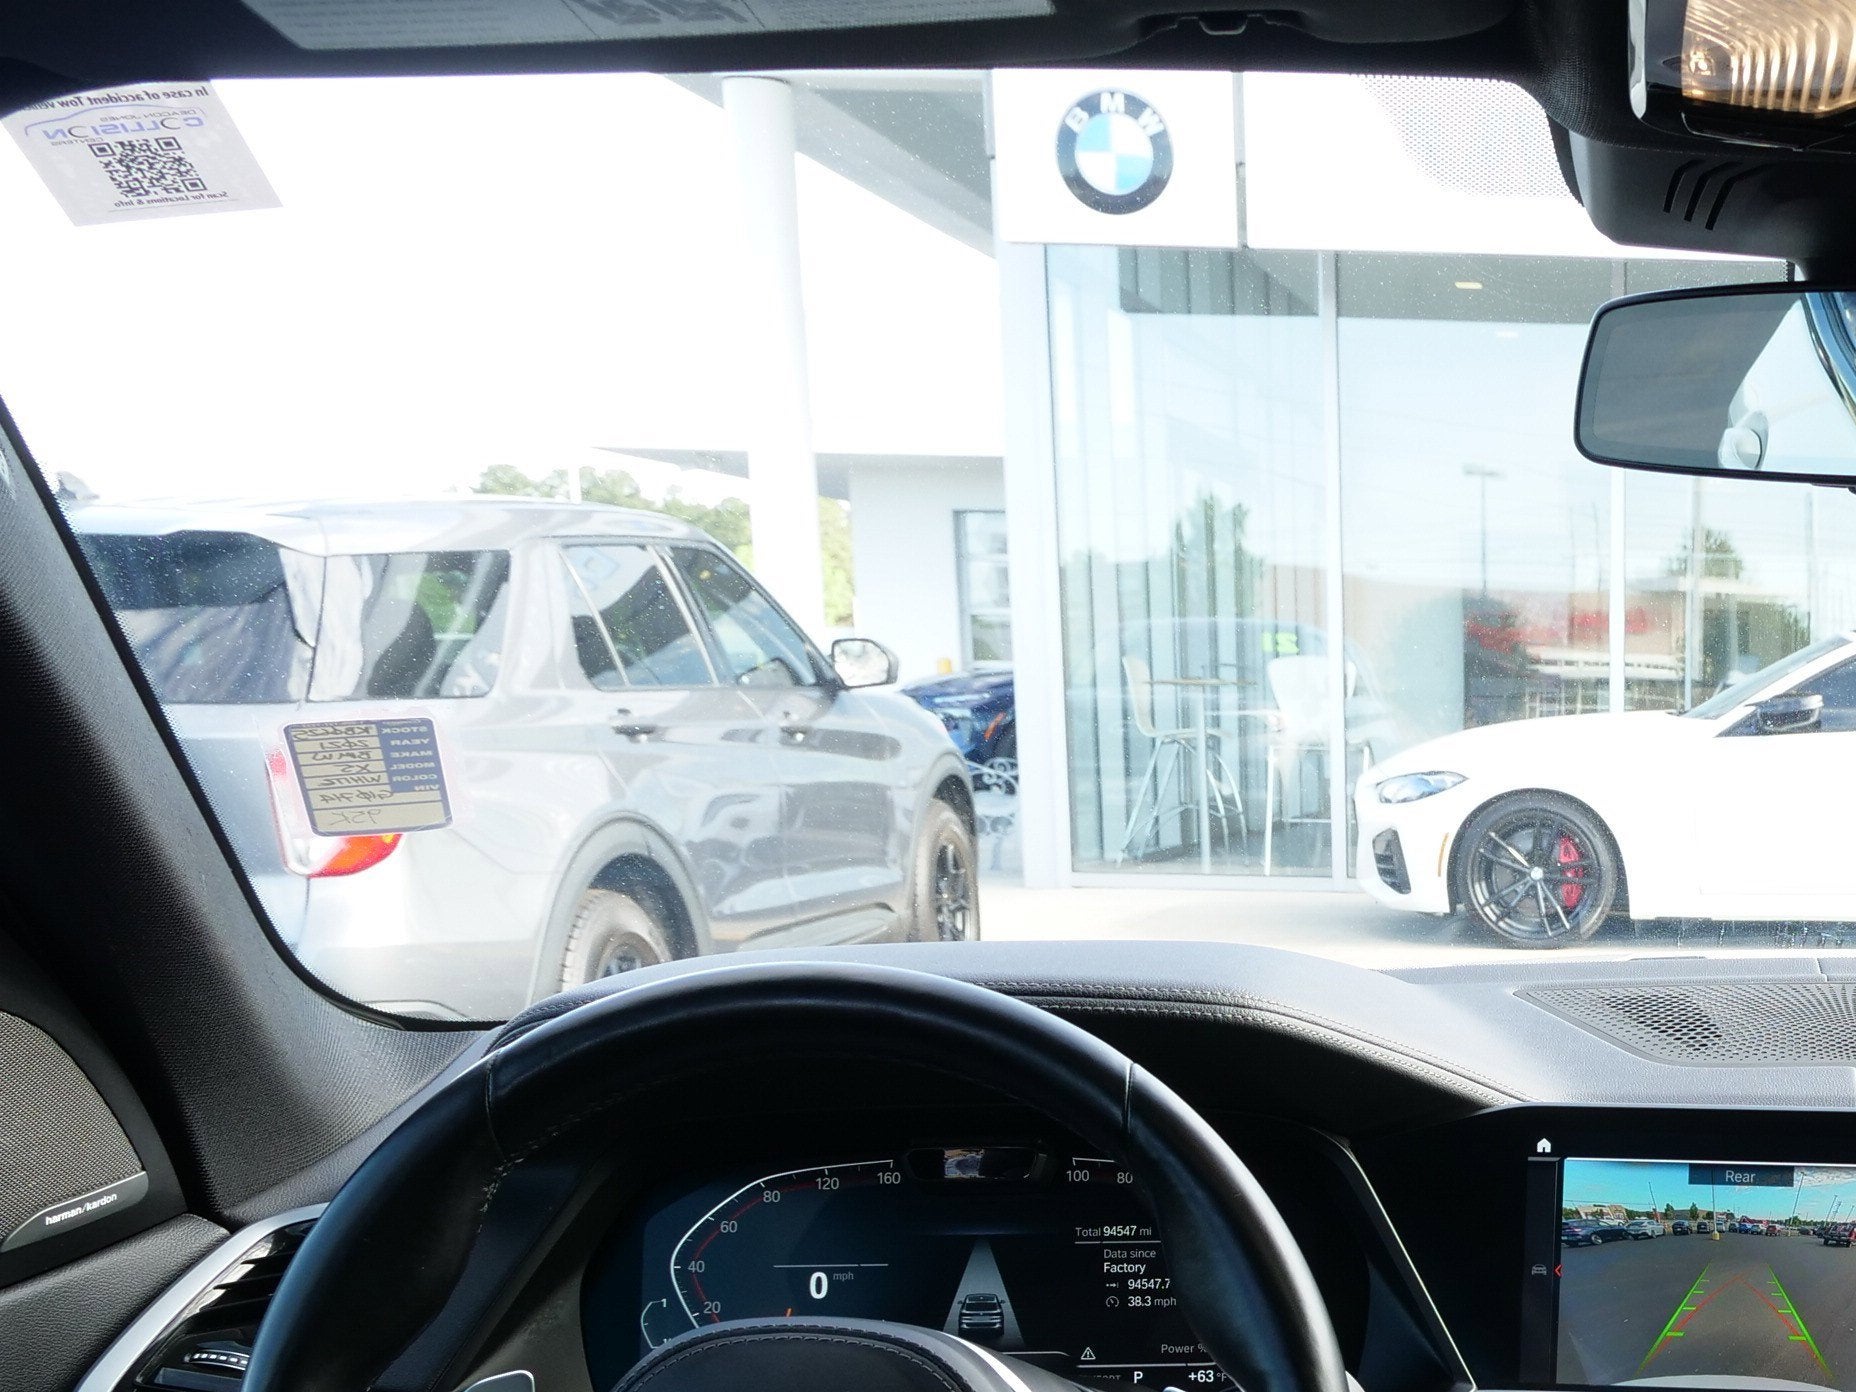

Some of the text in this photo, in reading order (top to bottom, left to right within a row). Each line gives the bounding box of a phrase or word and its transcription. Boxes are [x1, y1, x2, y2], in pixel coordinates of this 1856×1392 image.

[1064, 91, 1165, 137] BMW
[877, 1172, 901, 1185] 160
[1066, 1170, 1090, 1182] 100
[1117, 1172, 1133, 1184] 80
[1725, 1170, 1756, 1183] Rear
[815, 1177, 840, 1190] 120
[763, 1190, 781, 1203] 80
[45, 1193, 118, 1226] harman/kardon
[720, 1220, 738, 1233] 60
[1075, 1225, 1152, 1237] Total 94547 mi
[1103, 1248, 1157, 1259] Data since
[687, 1260, 706, 1273] 40
[1103, 1262, 1146, 1275] Factory
[809, 1271, 855, 1299] 0 mph
[703, 1301, 721, 1314] 20
[1128, 1295, 1177, 1308] 38.3 mph
[1160, 1343, 1194, 1354] Power
[1133, 1371, 1143, 1384] P
[1188, 1369, 1214, 1383] +63
